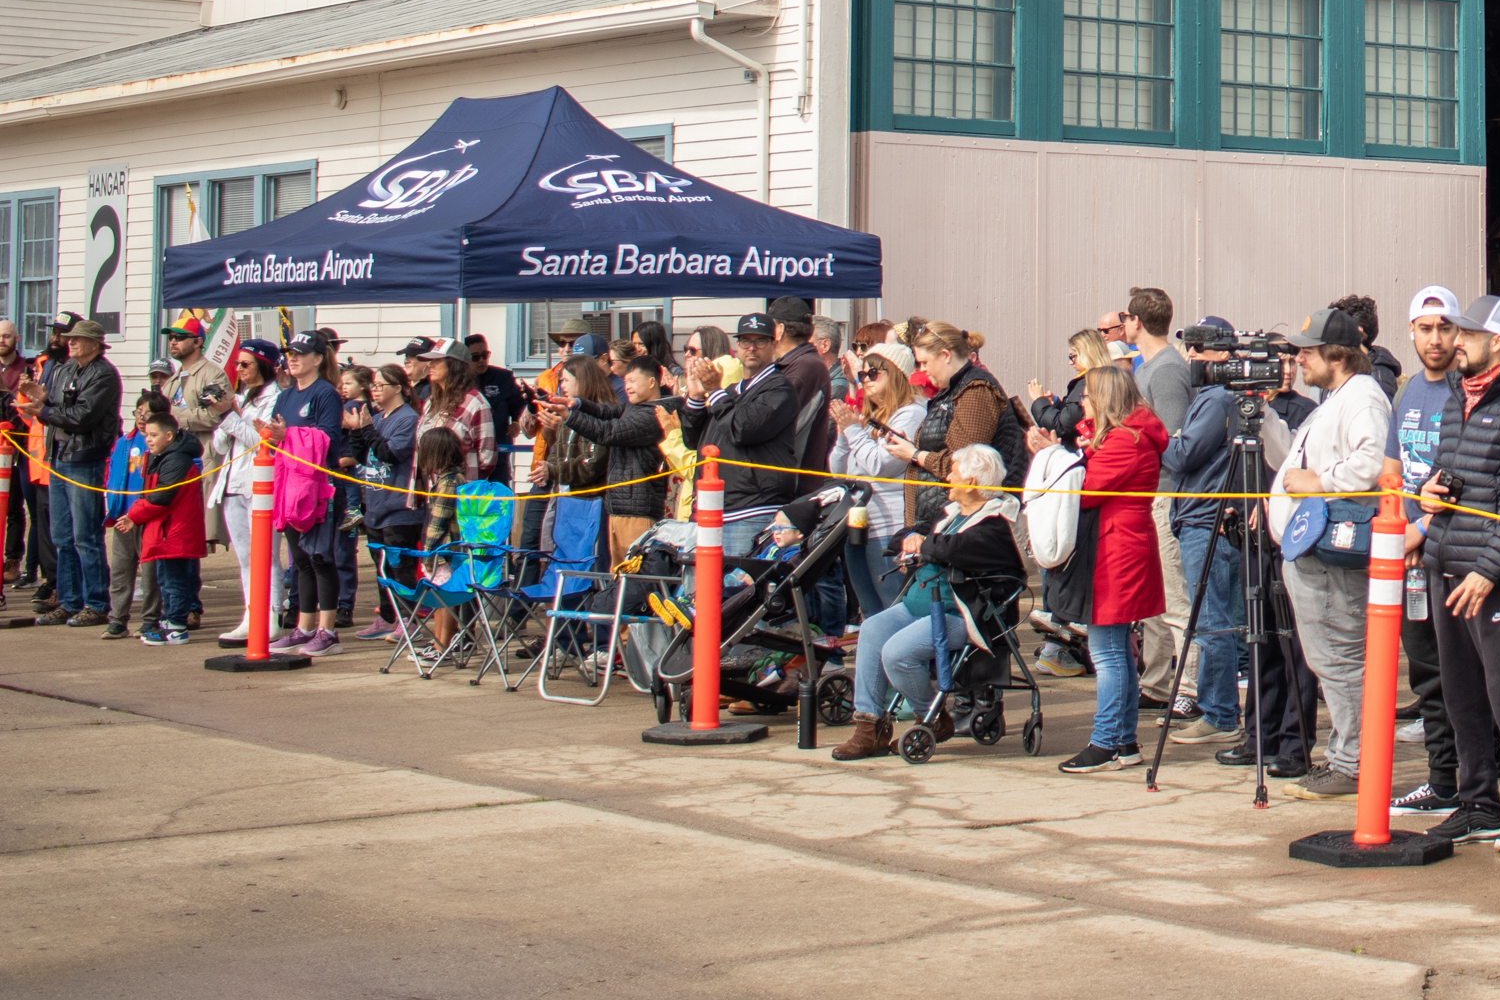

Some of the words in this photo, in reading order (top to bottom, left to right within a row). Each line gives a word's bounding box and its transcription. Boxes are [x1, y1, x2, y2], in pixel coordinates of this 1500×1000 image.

[88, 171, 126, 198] HANGAR
[566, 169, 693, 200] SBA
[570, 198, 612, 209] Santa
[611, 194, 667, 204] Barbara
[668, 194, 713, 204] Airport
[90, 204, 121, 334] 2
[223, 257, 262, 285] Santa
[263, 253, 318, 283] Barbara
[320, 249, 374, 285] Airport
[518, 246, 608, 276] Santa
[614, 243, 733, 276] Barbara
[738, 246, 836, 283] Airport
